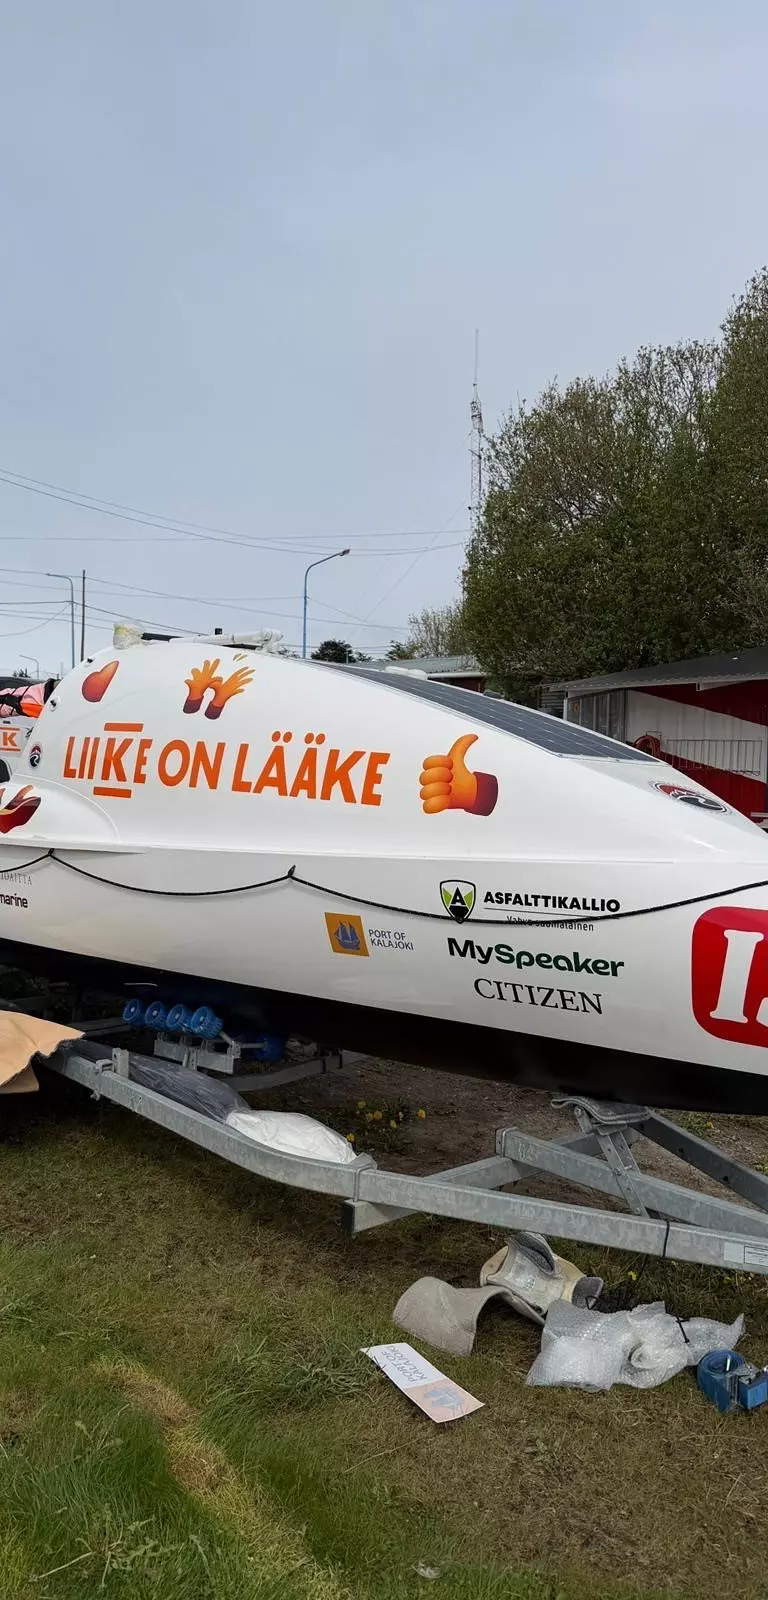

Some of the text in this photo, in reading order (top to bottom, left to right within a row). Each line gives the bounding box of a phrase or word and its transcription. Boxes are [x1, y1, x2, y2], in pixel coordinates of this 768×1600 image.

[63, 736, 153, 784] LIIKE
[158, 739, 226, 790] ON
[231, 730, 391, 806] LÄÄKE
[484, 891, 621, 912] ASFALTTIKALLIO
[368, 929, 406, 941] PORT OF
[370, 938, 414, 951] KALAJOKI
[447, 937, 625, 977] MySpeaker
[473, 978, 603, 1015] CITIZEN
